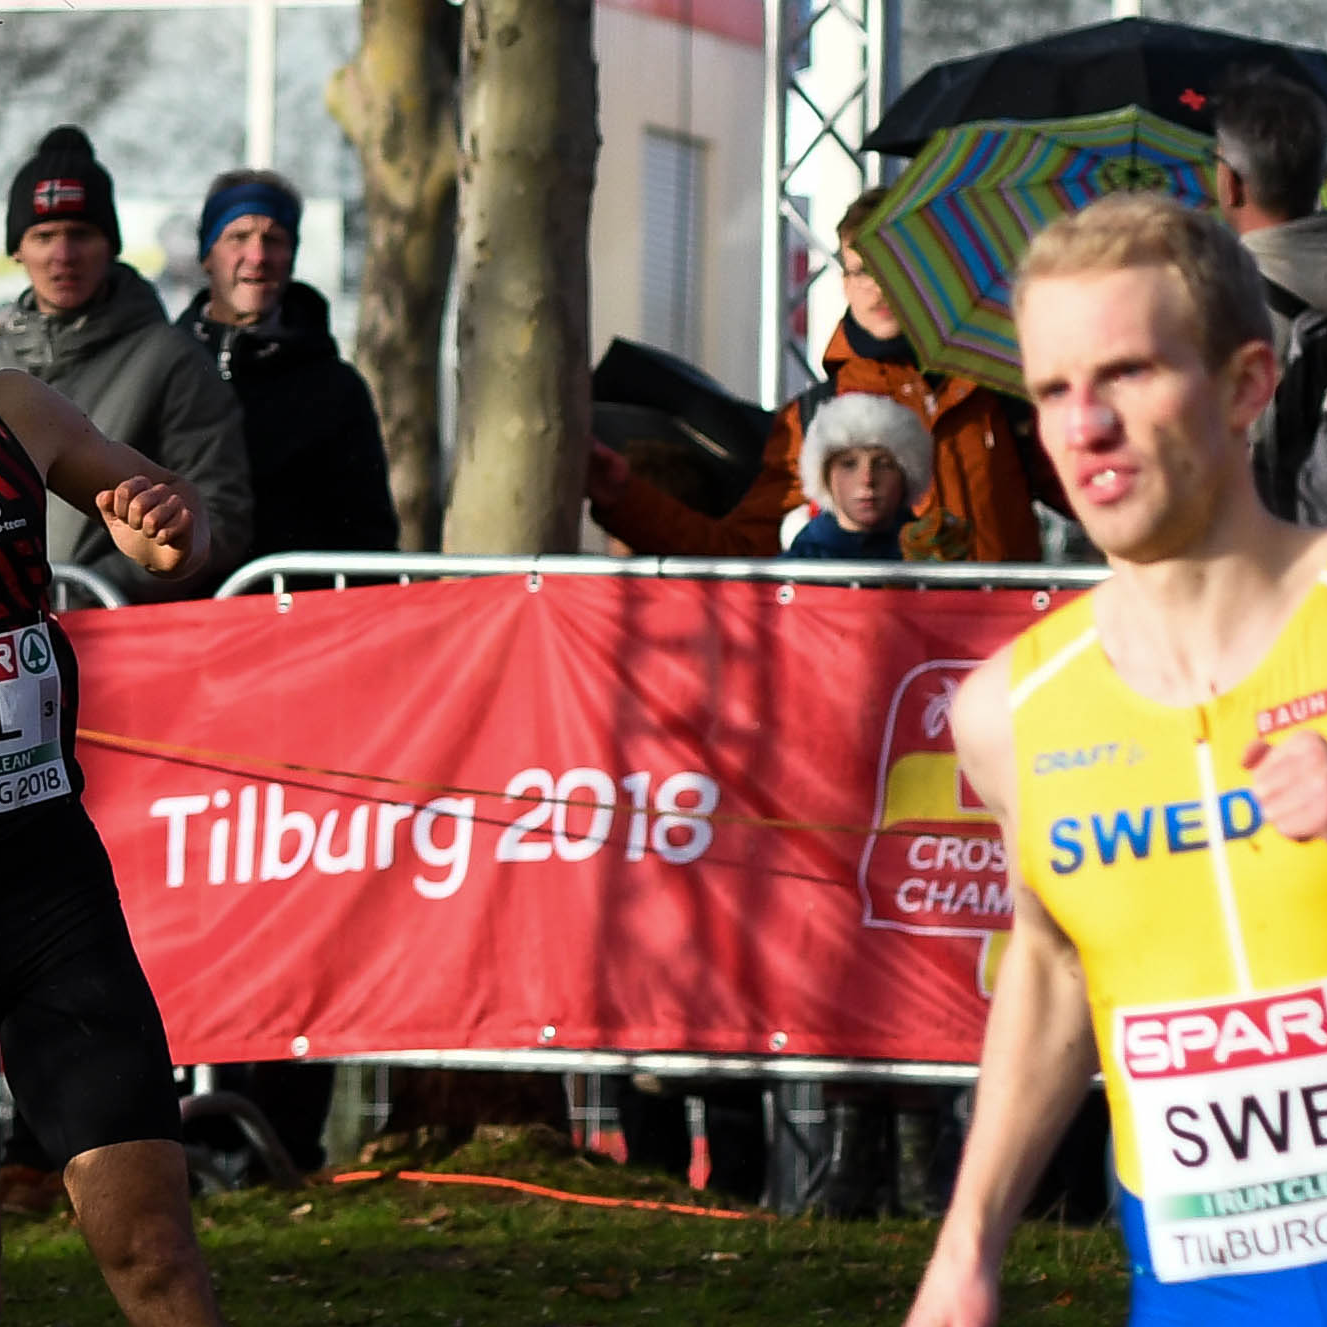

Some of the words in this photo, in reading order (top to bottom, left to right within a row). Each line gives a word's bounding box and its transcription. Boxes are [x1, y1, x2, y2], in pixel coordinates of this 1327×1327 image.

[43, 700, 54, 717] 3
[17, 767, 61, 799] 2018
[149, 783, 476, 900] Tilburg
[494, 768, 721, 865] 2018
[1050, 786, 1265, 876] SWED
[907, 835, 1008, 873] CROS
[1213, 1183, 1279, 1216] RUN
